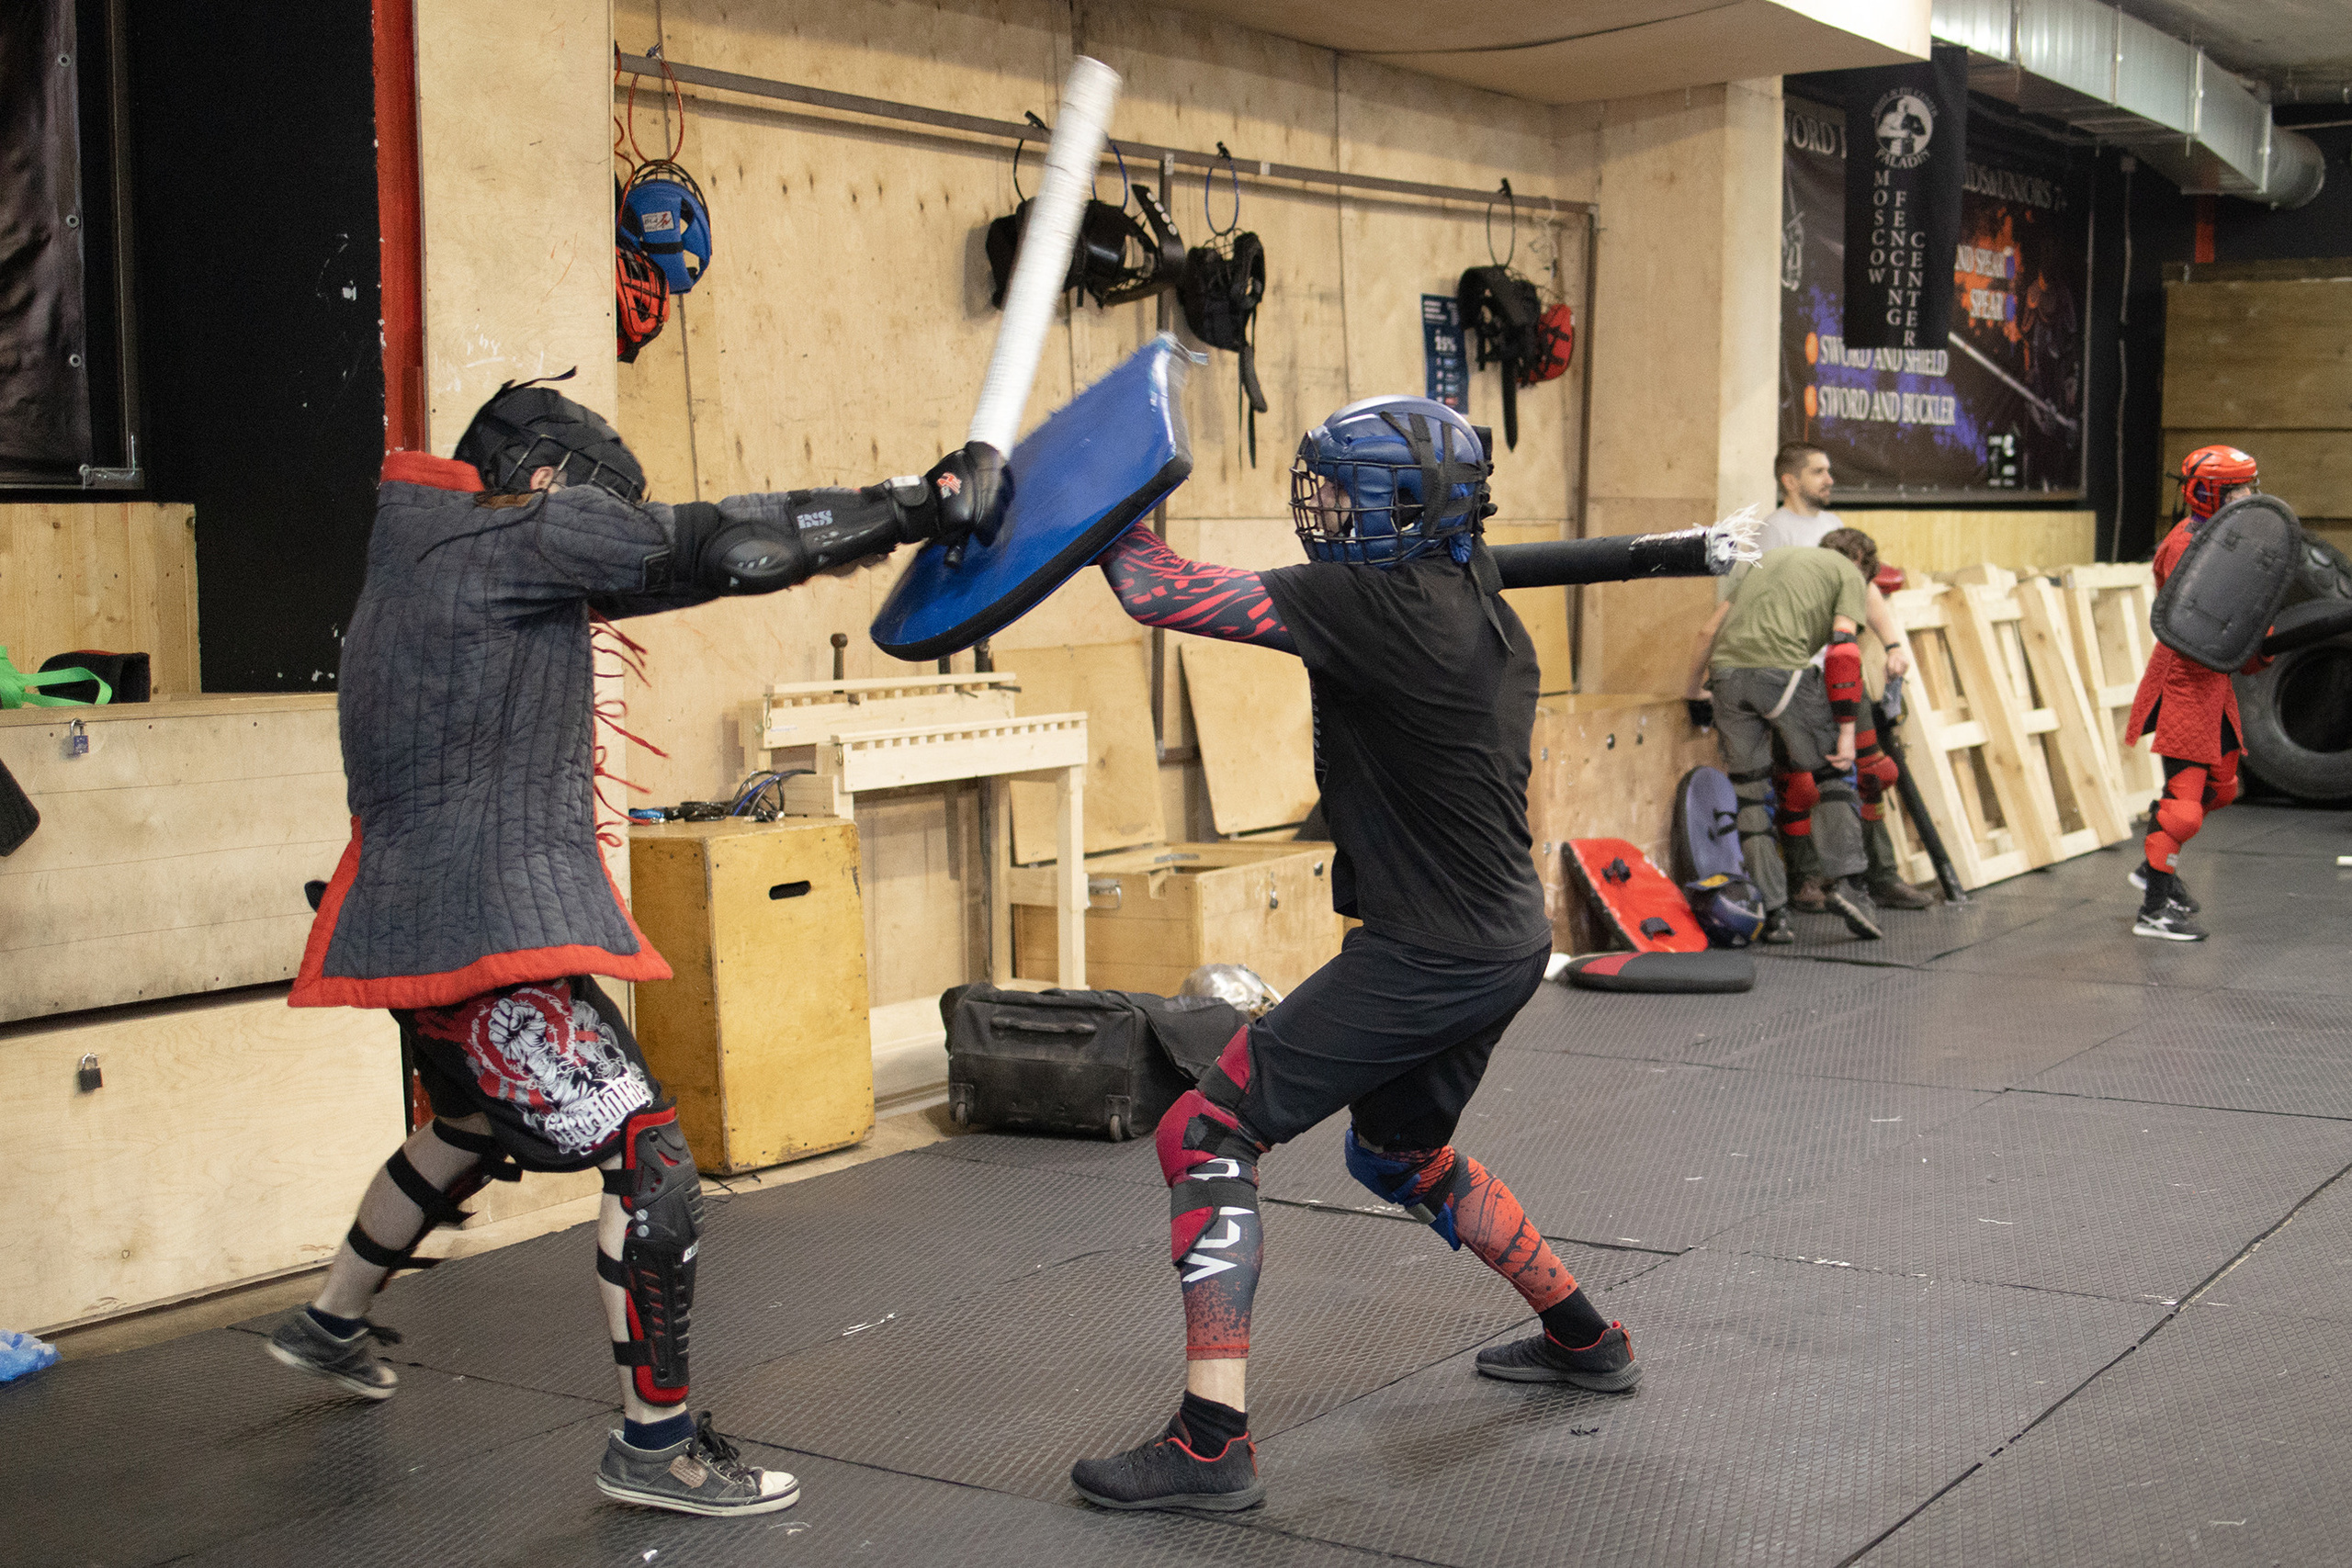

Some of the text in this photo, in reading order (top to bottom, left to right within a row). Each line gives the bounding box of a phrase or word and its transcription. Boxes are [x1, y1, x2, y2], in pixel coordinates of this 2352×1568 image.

[1784, 114, 1837, 155] ORD
[1868, 169, 1890, 285] MOSCOW
[1886, 190, 1908, 326] FENCING
[1903, 231, 1927, 347] CENTER
[1818, 384, 1956, 427] SWORD AND BUCKLER
